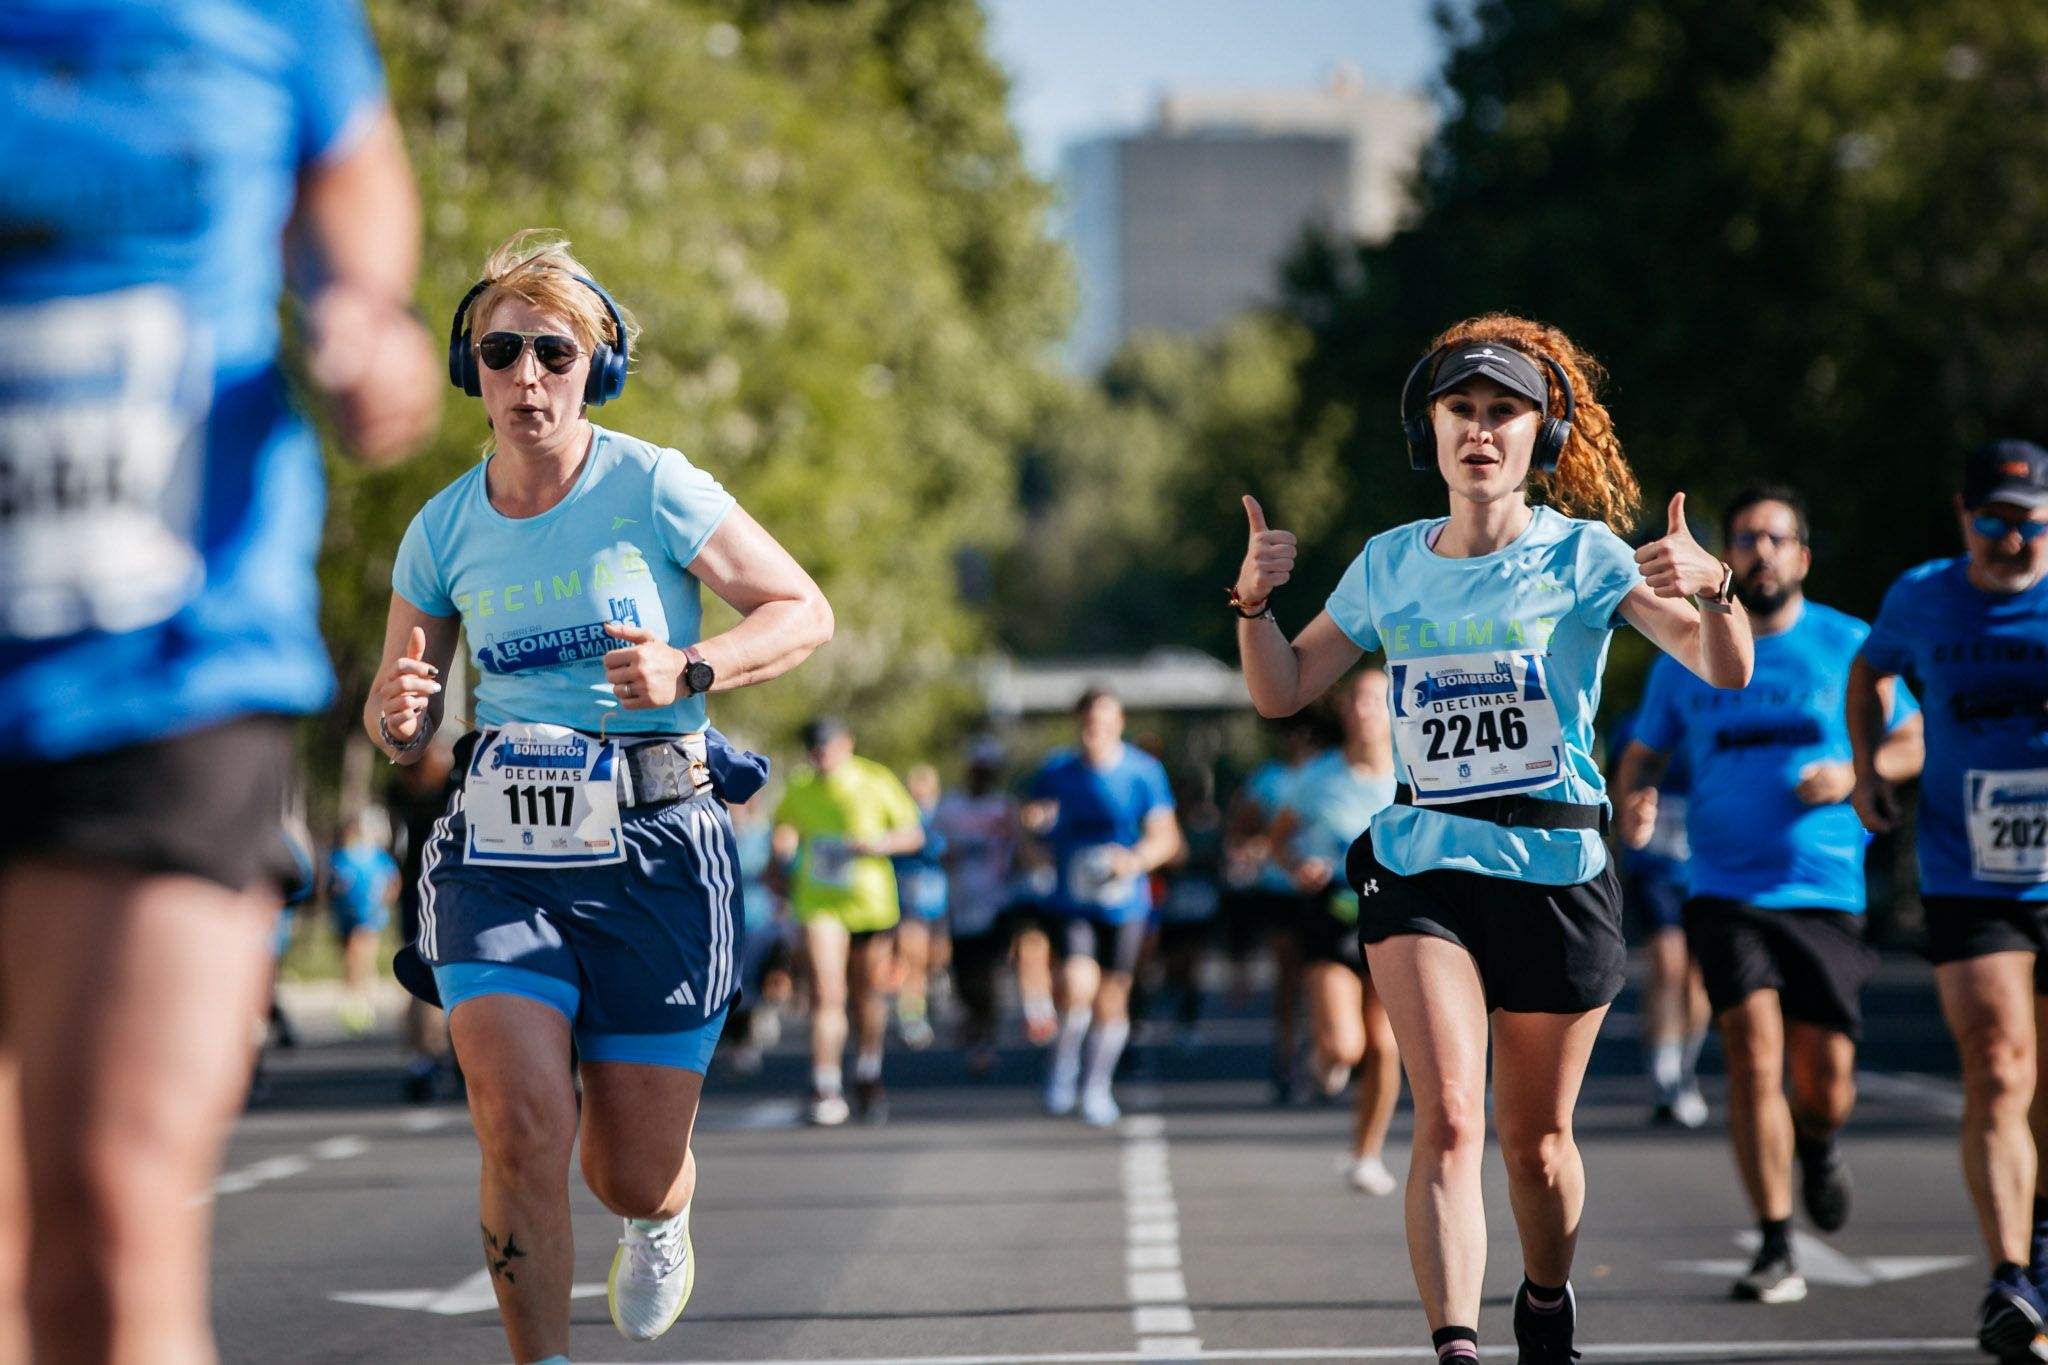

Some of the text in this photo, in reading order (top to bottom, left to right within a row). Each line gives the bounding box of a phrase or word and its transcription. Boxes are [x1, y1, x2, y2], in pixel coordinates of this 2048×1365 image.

[504, 616, 637, 657] BOMBER
[559, 647, 577, 661] de
[1437, 673, 1511, 688] BOMBEROS
[1433, 693, 1517, 714] DECIMAS
[1422, 707, 1528, 762] 2246
[513, 743, 585, 757] BOMBEROS
[505, 767, 582, 782] DECIMAS
[503, 784, 575, 827] 1117
